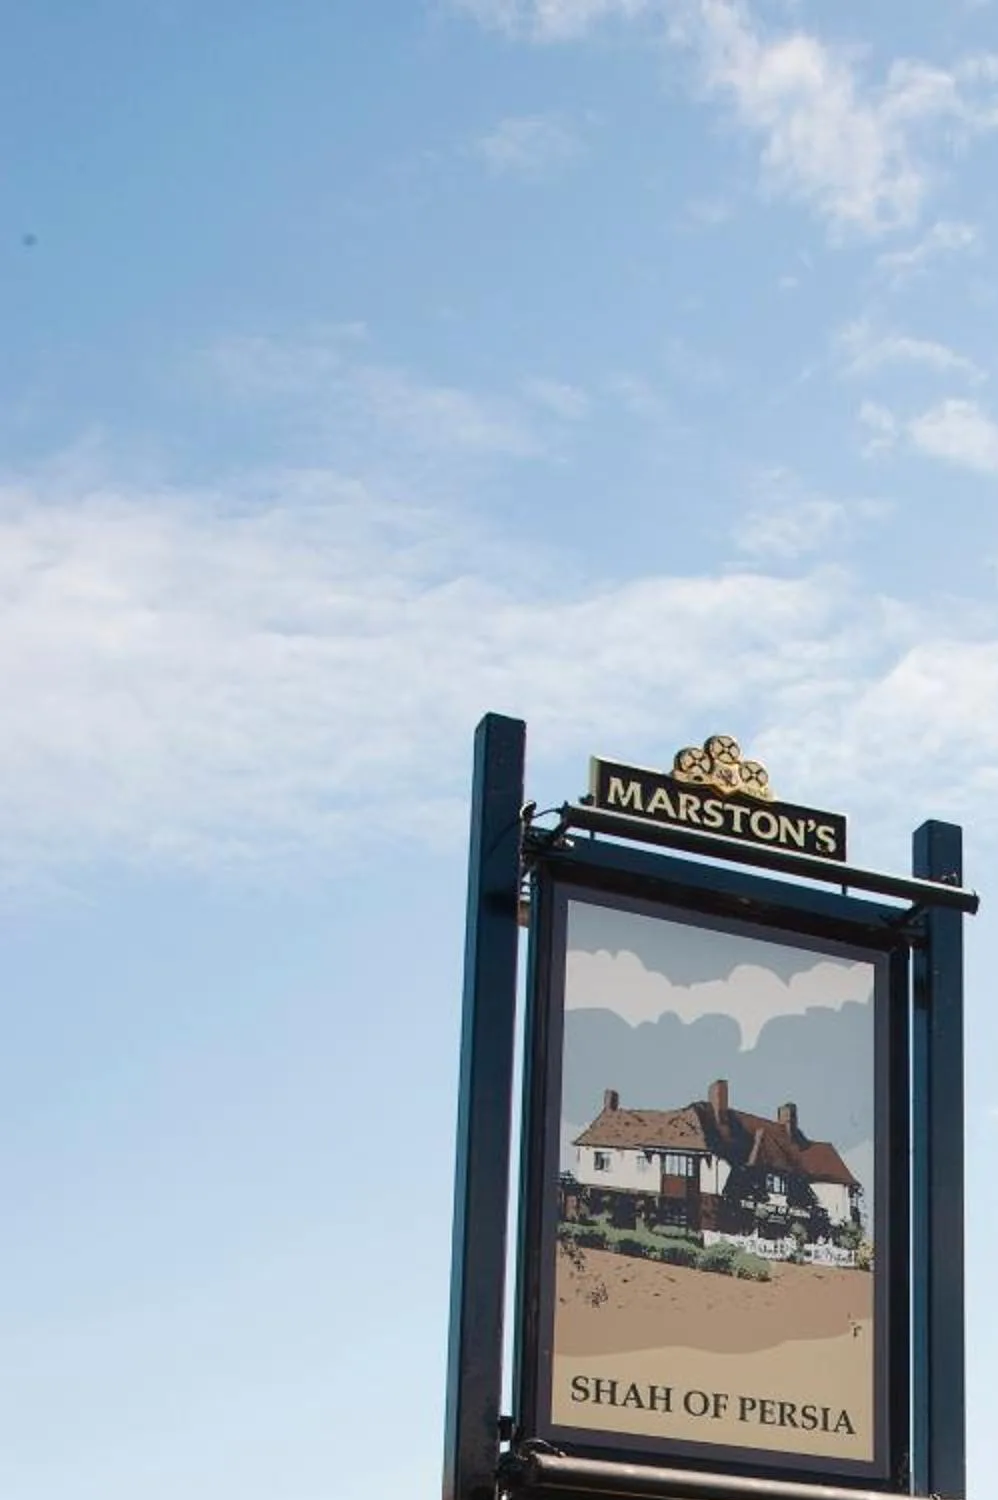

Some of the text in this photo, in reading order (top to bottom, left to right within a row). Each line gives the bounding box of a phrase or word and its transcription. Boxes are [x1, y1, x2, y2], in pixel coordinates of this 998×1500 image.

[607, 776, 837, 852] MARSTON'S
[571, 1375, 857, 1435] SHAH OF PERSIA
